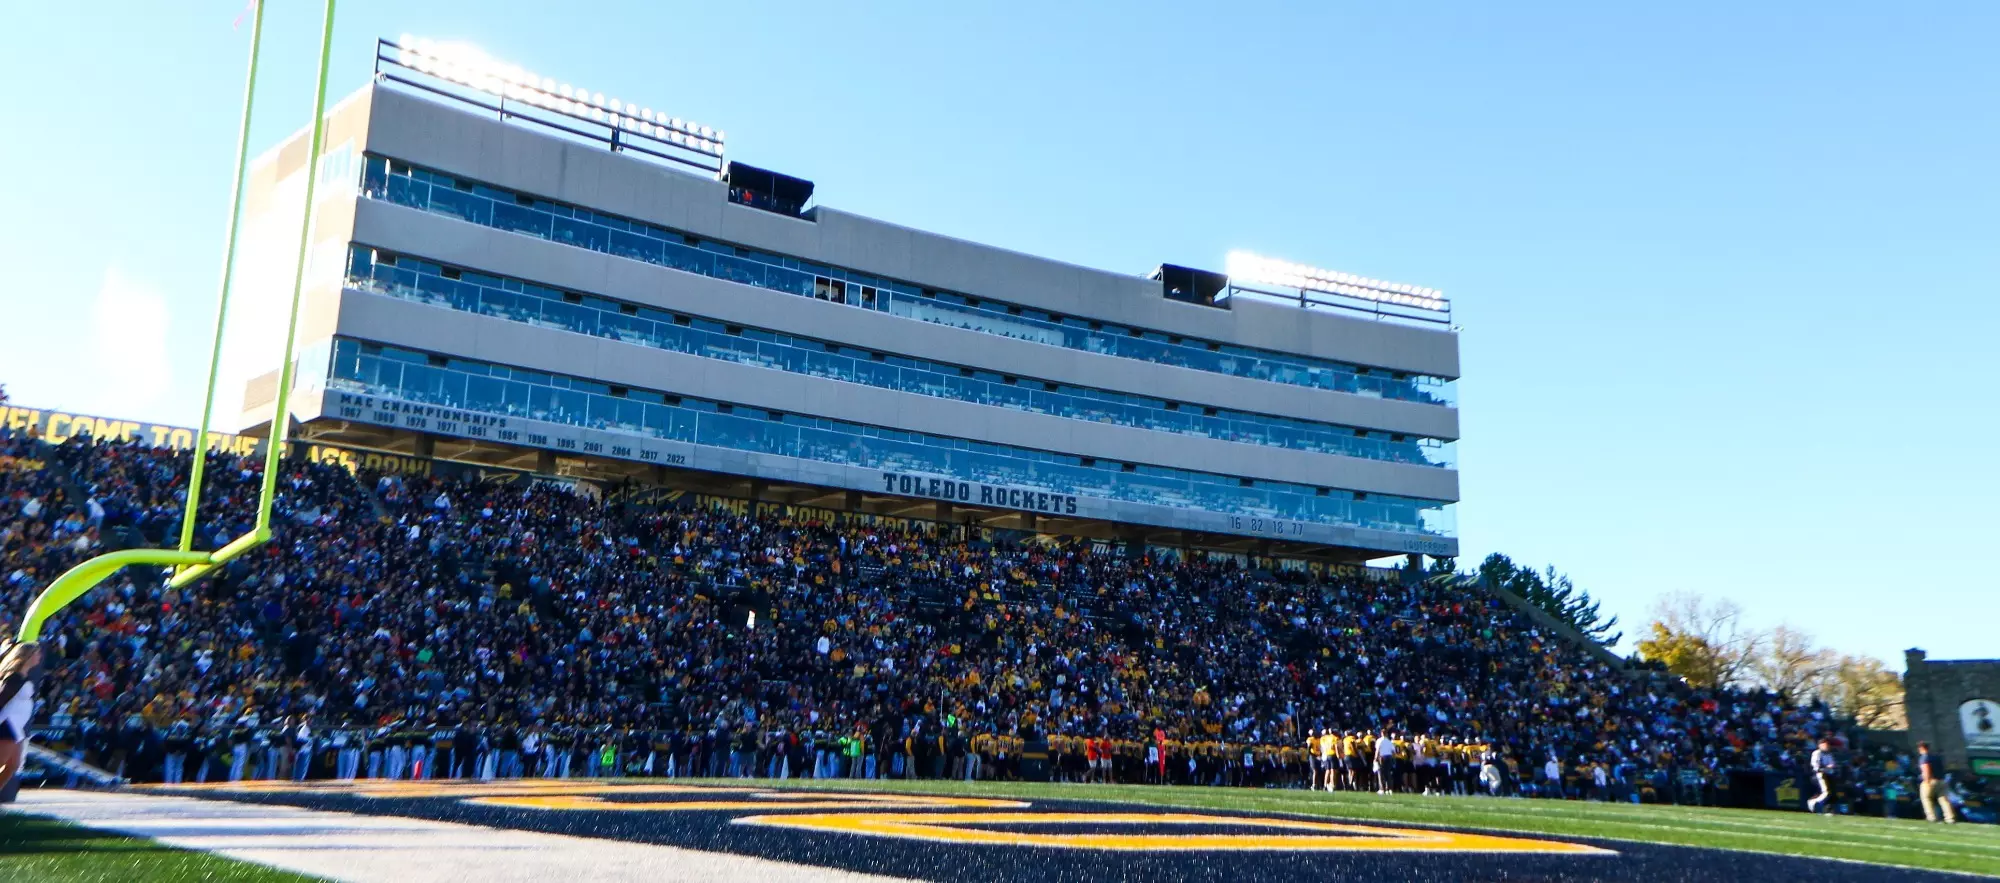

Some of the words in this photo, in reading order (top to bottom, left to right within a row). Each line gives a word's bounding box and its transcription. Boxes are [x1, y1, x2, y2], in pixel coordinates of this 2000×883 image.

[341, 393, 373, 408] MAC
[382, 400, 506, 428] CHAMPIONSHIPS
[151, 425, 192, 458] TO
[340, 406, 362, 417] 1967
[437, 421, 456, 432] 1971
[498, 429, 518, 440] 1984
[557, 438, 576, 449] 1995
[584, 441, 603, 453] 2001
[612, 445, 631, 456] 2004
[640, 449, 658, 460] 2017
[667, 453, 685, 464] 2022
[883, 472, 970, 501] TOLEDO
[980, 484, 1077, 514] ROCKETS
[1231, 516, 1241, 530] 16
[1251, 518, 1263, 532] 82
[1272, 520, 1283, 534] 18
[1291, 522, 1303, 536] 77
